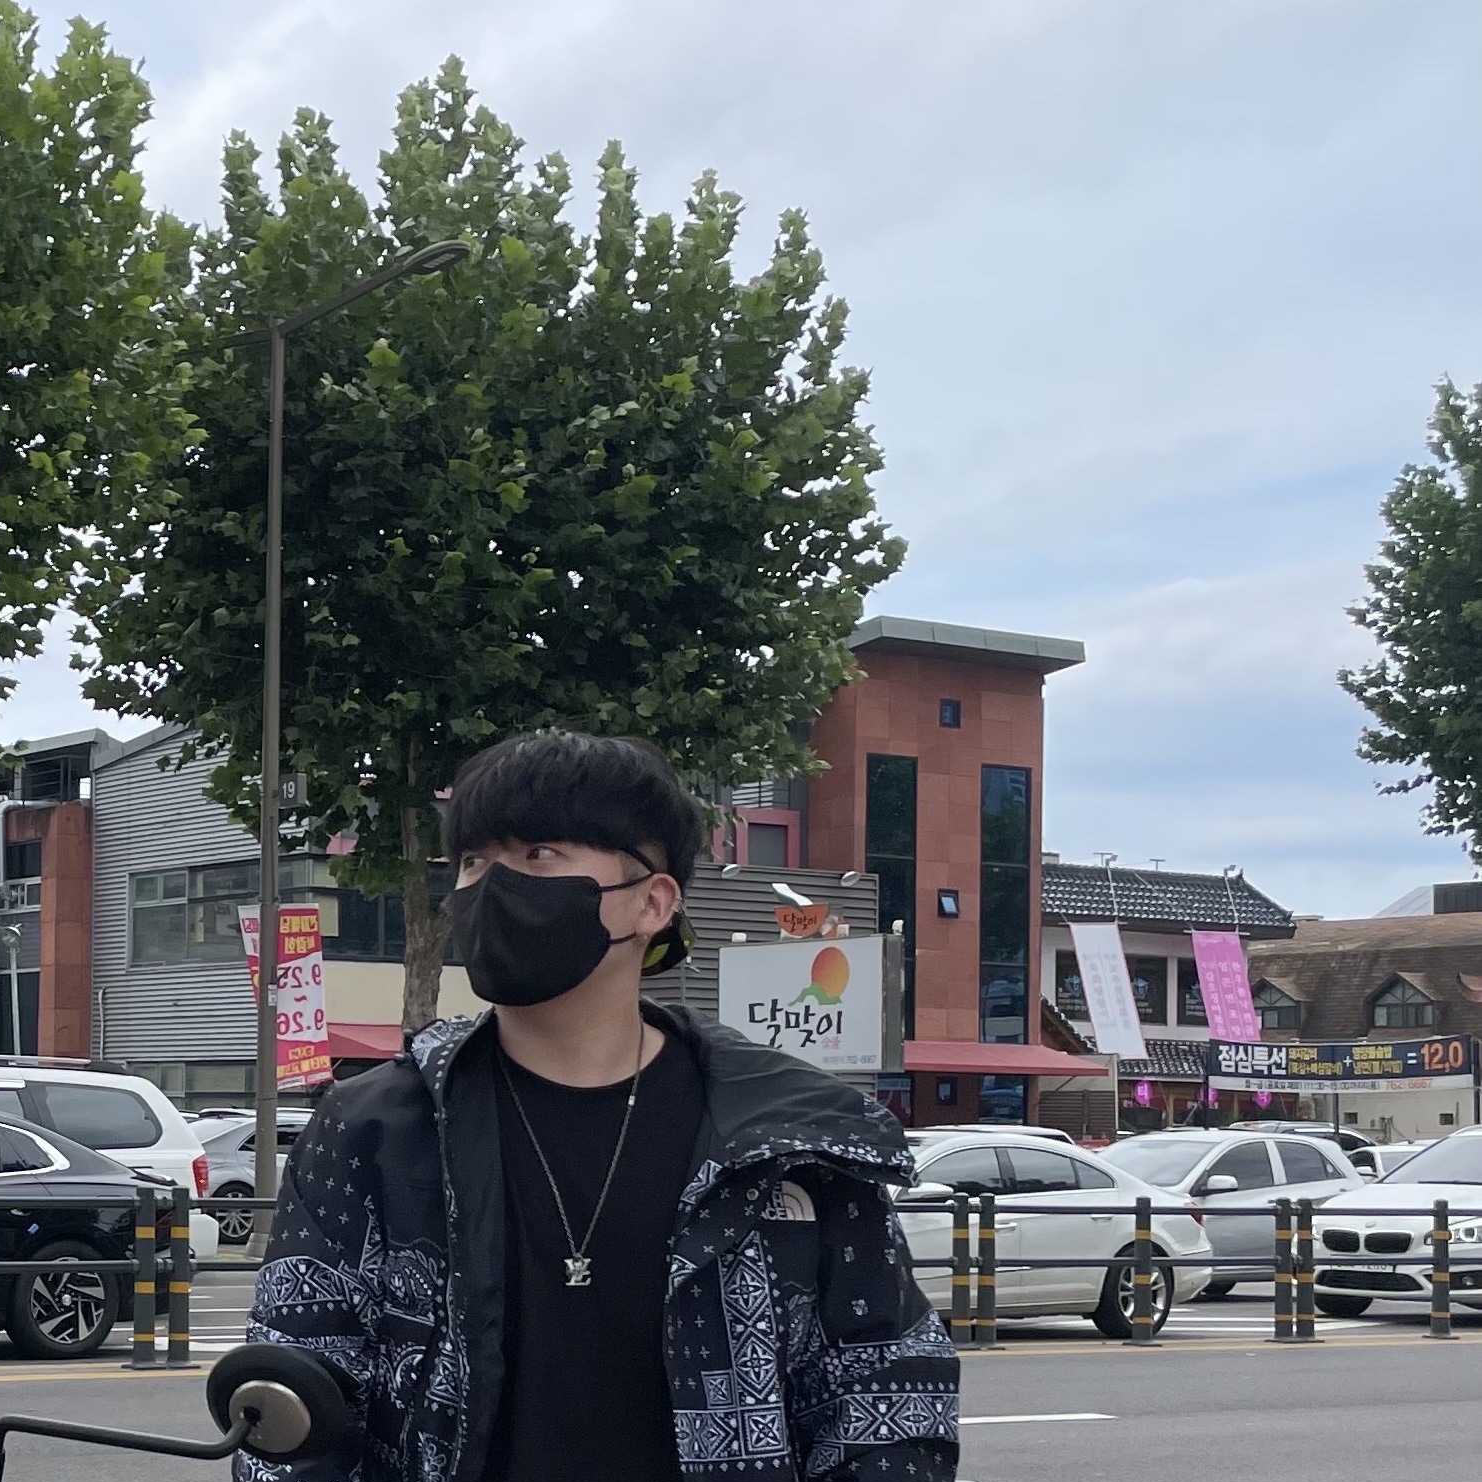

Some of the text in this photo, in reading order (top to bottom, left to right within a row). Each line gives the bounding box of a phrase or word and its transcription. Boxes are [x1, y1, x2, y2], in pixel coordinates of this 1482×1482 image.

[282, 781, 295, 799] 19
[783, 913, 817, 932] 달맞이
[748, 998, 843, 1049] 달맞이
[1218, 1044, 1287, 1075] 점심특선
